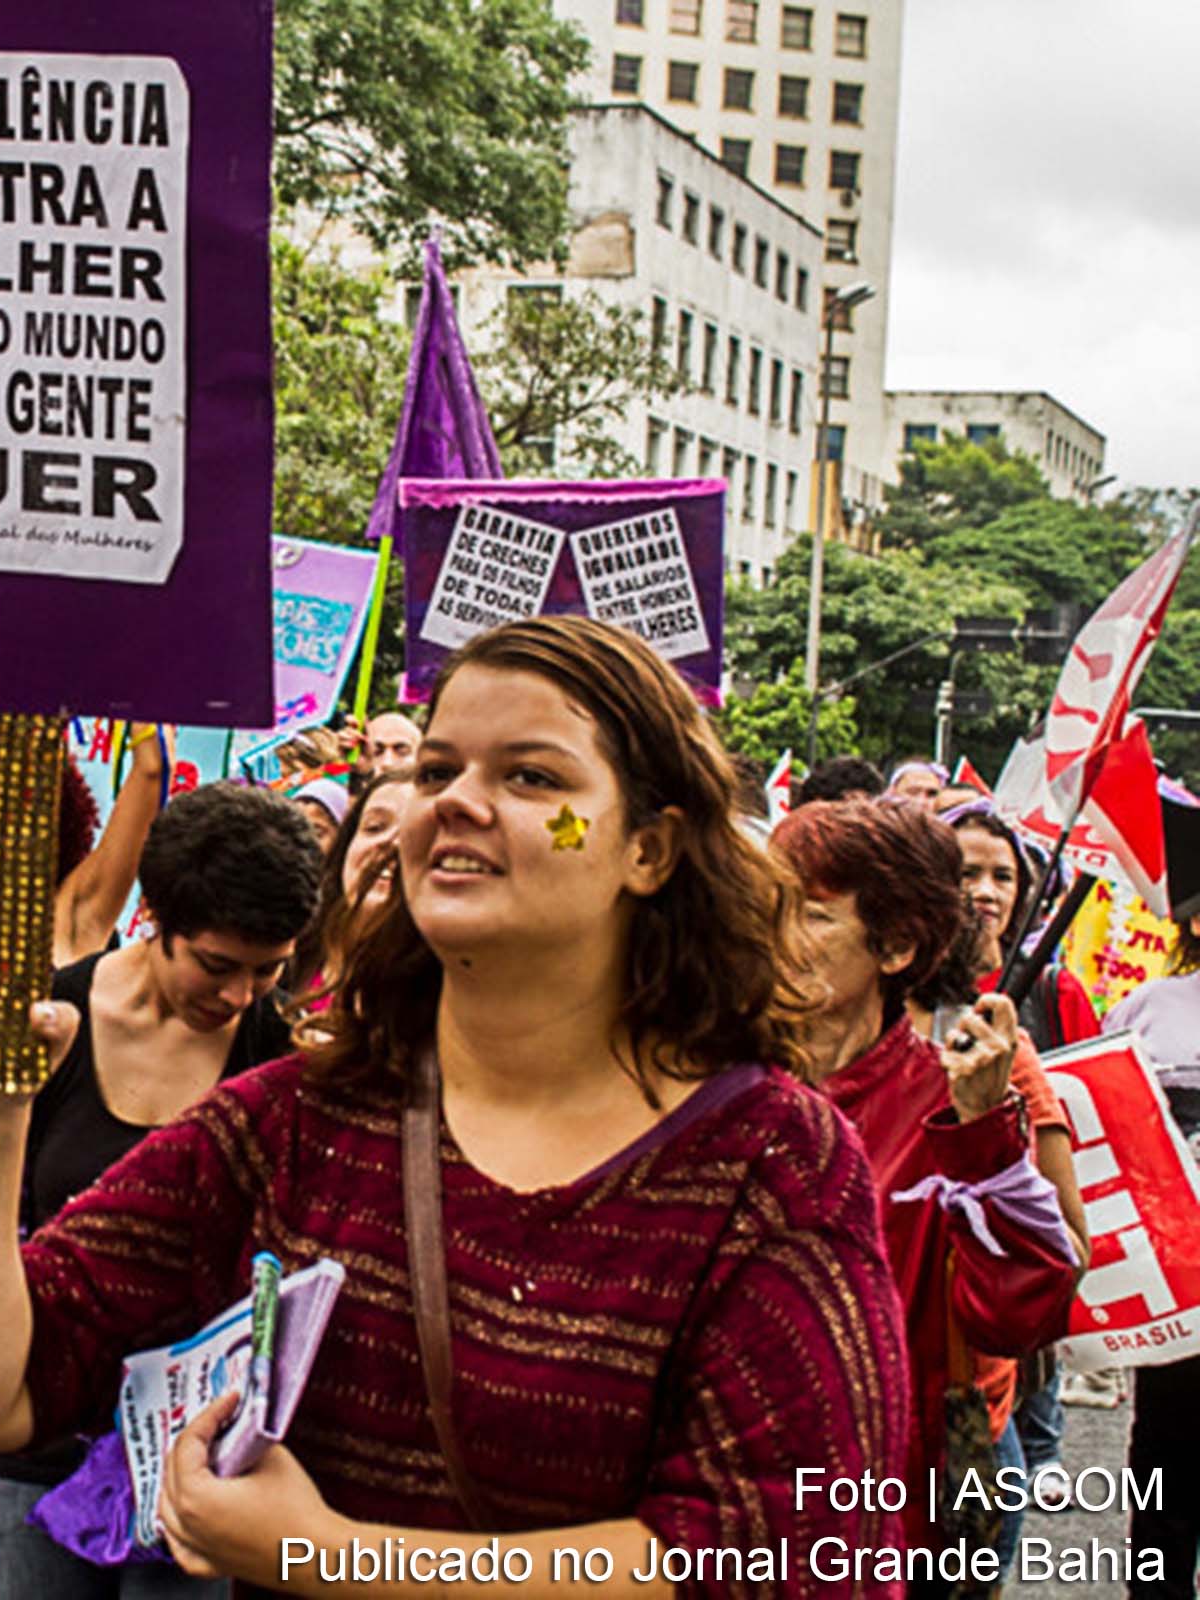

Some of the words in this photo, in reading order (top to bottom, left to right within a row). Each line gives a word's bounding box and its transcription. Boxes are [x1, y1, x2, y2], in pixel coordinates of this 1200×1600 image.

[126, 167, 168, 233] A
[24, 310, 166, 364] MUNDO
[6, 370, 153, 443] GENTE
[25, 526, 59, 544] das
[63, 530, 156, 553] Mulheres
[464, 507, 557, 555] GARANTIA
[578, 513, 676, 556] QUEREMOS
[449, 552, 482, 578] PARA
[482, 560, 500, 584] OS
[499, 565, 544, 598] FILHOS
[455, 531, 478, 554] DE
[479, 536, 550, 578] CRECHES
[583, 536, 683, 581] IGUALDADE
[443, 574, 469, 598] DE
[473, 583, 537, 618] TODAS
[591, 581, 612, 602] DE
[596, 597, 638, 621] ENTRE
[639, 584, 693, 613] HOMENS
[621, 606, 698, 642] ULHERES
[1103, 1319, 1192, 1352] BRASIL
